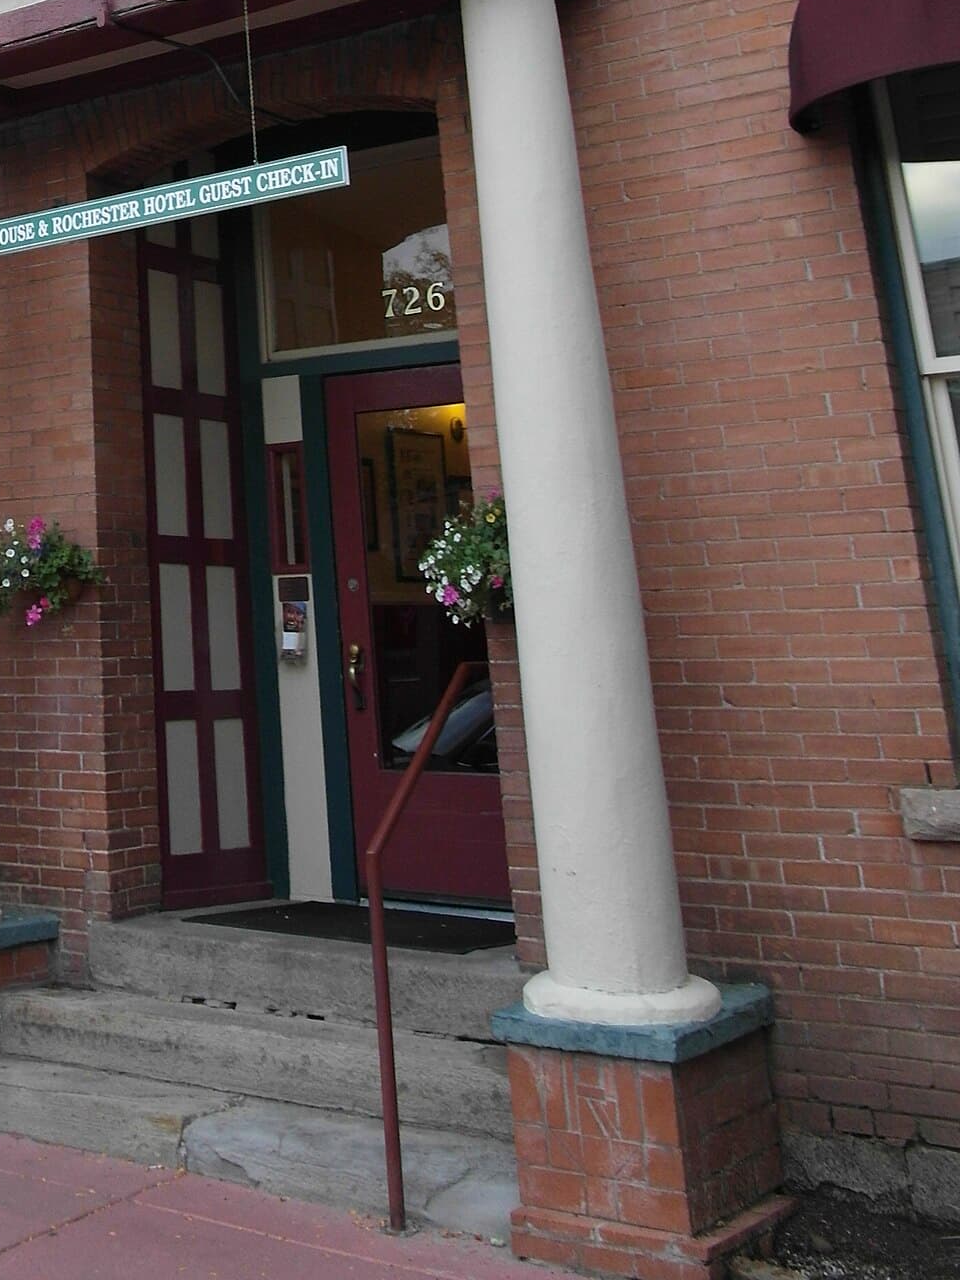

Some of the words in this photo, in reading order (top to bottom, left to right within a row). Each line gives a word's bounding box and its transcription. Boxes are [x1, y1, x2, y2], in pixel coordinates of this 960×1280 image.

[38, 220, 49, 237] &
[52, 202, 140, 234] ROCHESTER
[143, 189, 196, 216] HOTEL
[199, 176, 253, 204] GUEST
[256, 157, 339, 192] CHECK-IN
[382, 282, 445, 318] 726
